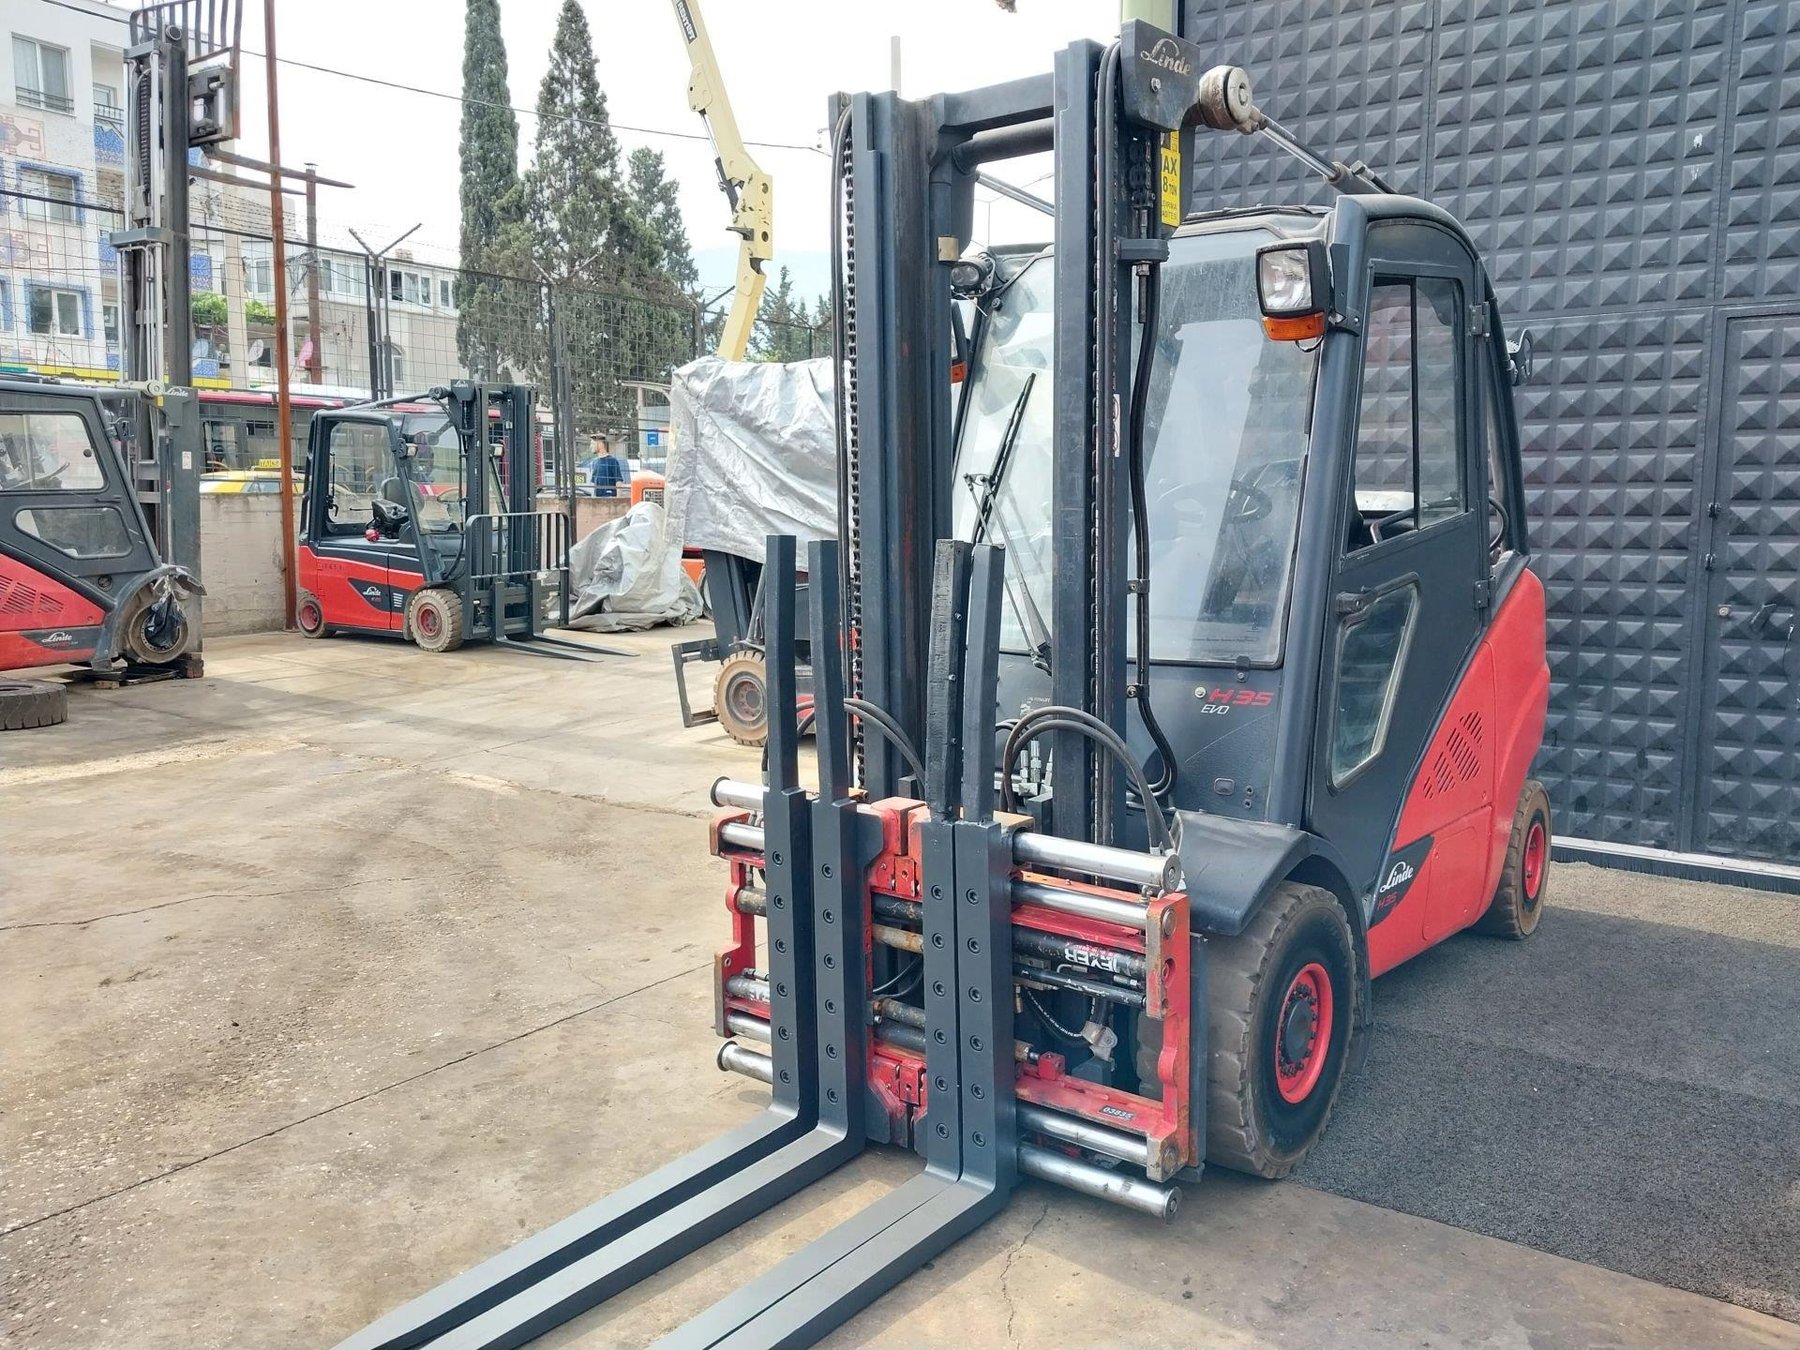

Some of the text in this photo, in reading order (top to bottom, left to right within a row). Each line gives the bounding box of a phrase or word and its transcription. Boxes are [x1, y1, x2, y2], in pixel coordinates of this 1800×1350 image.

[1140, 38, 1192, 77] Linde
[42, 632, 73, 643] Linde
[1201, 704, 1230, 715] EVO
[1379, 861, 1414, 893] Linde
